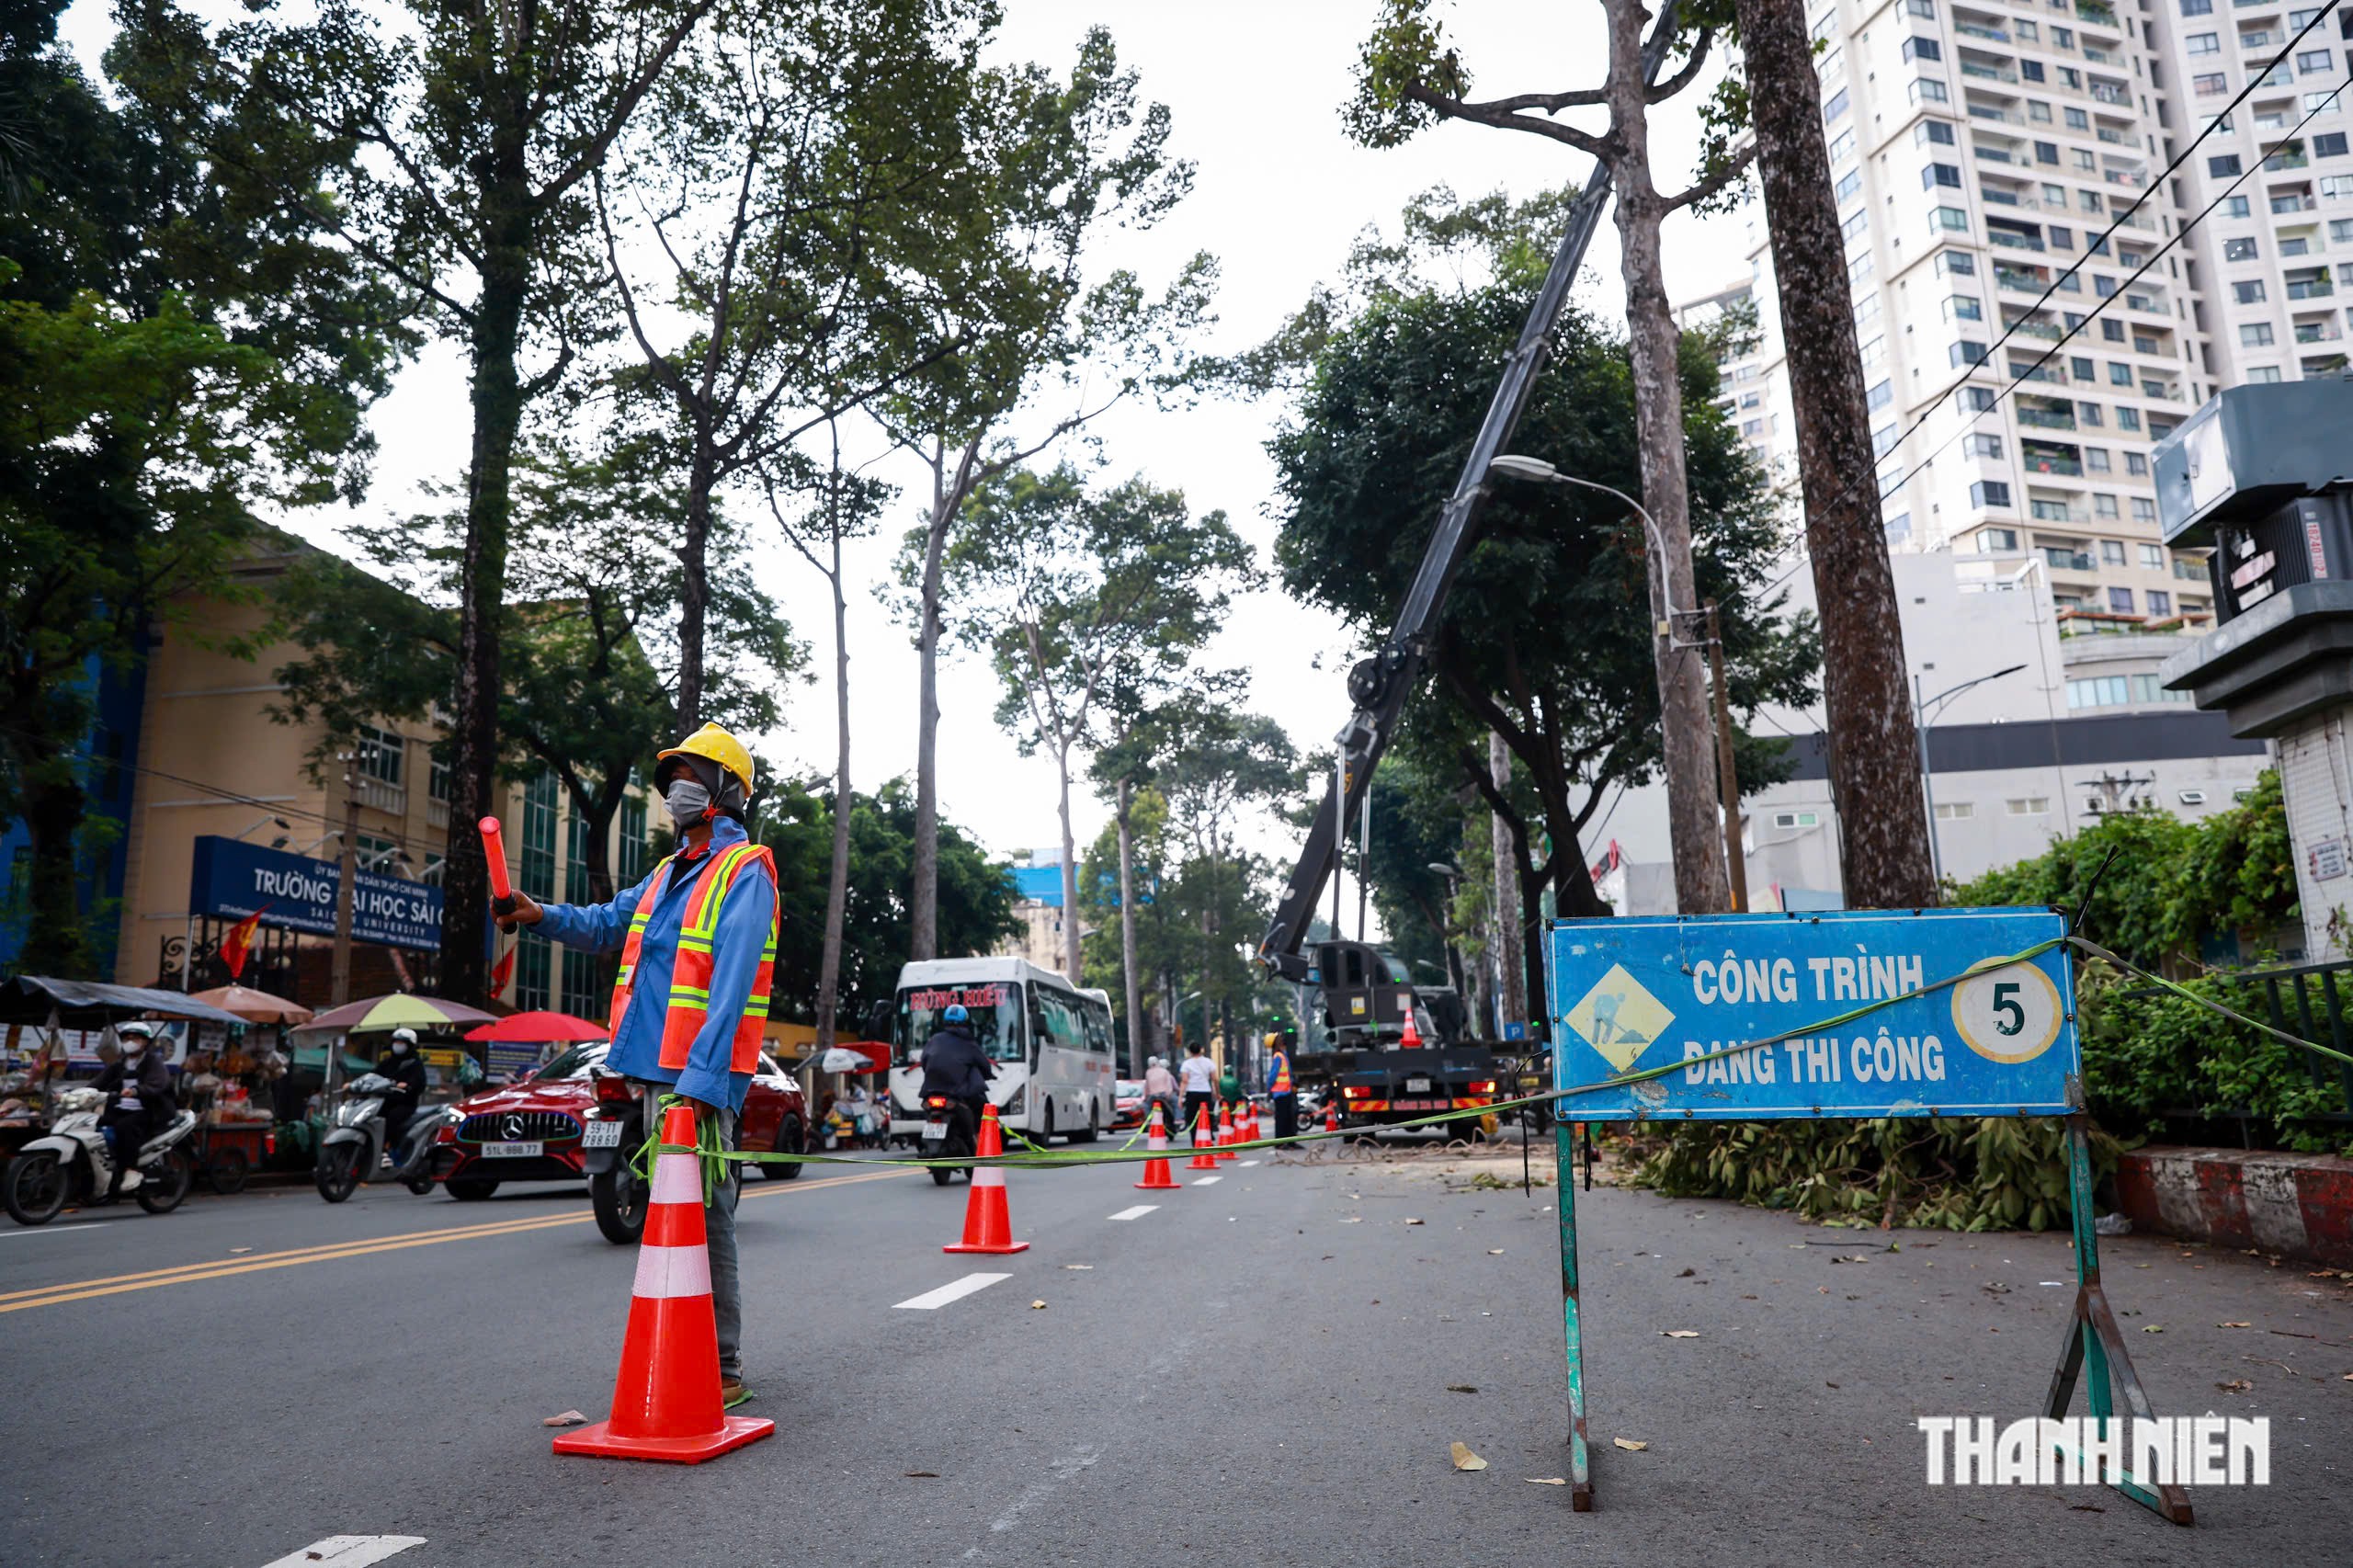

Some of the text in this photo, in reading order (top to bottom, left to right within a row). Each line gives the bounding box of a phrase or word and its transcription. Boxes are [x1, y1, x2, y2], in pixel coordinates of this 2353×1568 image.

[255, 868, 332, 904] TRƯỜNG
[369, 892, 405, 920] HỌC
[411, 898, 434, 926] SÀI
[363, 917, 426, 937] UNIVERSITY
[1693, 943, 1925, 1005] CÔNG TRÌNH
[1992, 983, 2026, 1036] 5
[1784, 1038, 1841, 1084] THI
[1850, 1026, 1946, 1083] CÔNG
